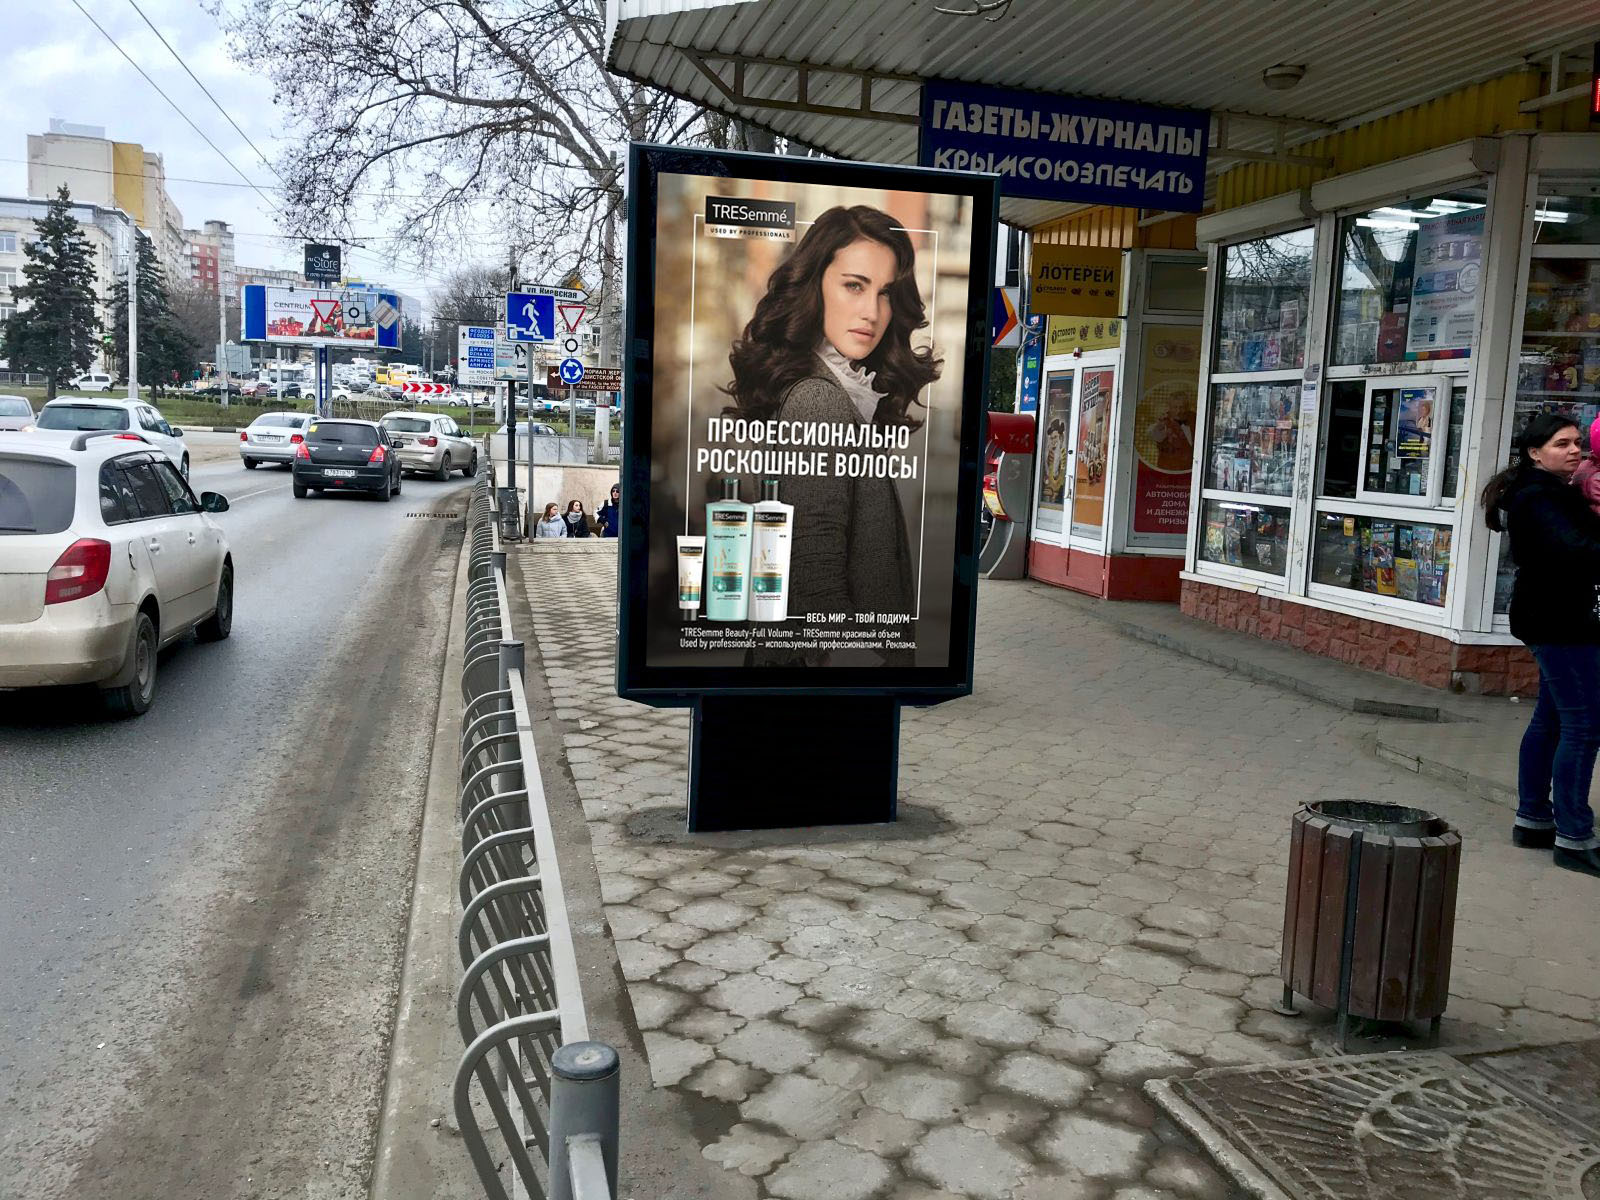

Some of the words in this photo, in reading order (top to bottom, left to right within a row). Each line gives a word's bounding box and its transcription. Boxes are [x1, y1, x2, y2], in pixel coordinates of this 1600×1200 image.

[932, 100, 1202, 157] ГАЗЕТЫ-ЖУРНАЛЫ
[933, 147, 1193, 194] КРЫМСОЮЗПЕЧАТЬ
[712, 203, 787, 223] TRESemmé
[739, 230, 790, 238] PROFESSIONALS
[273, 301, 311, 310] CENTRUM
[708, 417, 910, 450] ПРОФЕССИОНАЛЬНО
[696, 448, 828, 477] РОСКОШНЫЕ
[834, 453, 918, 479] ВОЛОСЫ
[806, 612, 826, 623] ВЕСЬ
[828, 613, 846, 623] МИР
[855, 611, 875, 624] ТВОЙ
[877, 613, 910, 625] ПОДИУМ
[767, 628, 794, 638] Volume
[841, 629, 877, 640] красивый
[877, 629, 901, 638] объем
[680, 638, 698, 648] Used
[699, 638, 707, 650] by
[709, 638, 756, 650] professionals
[765, 639, 818, 650] используемый
